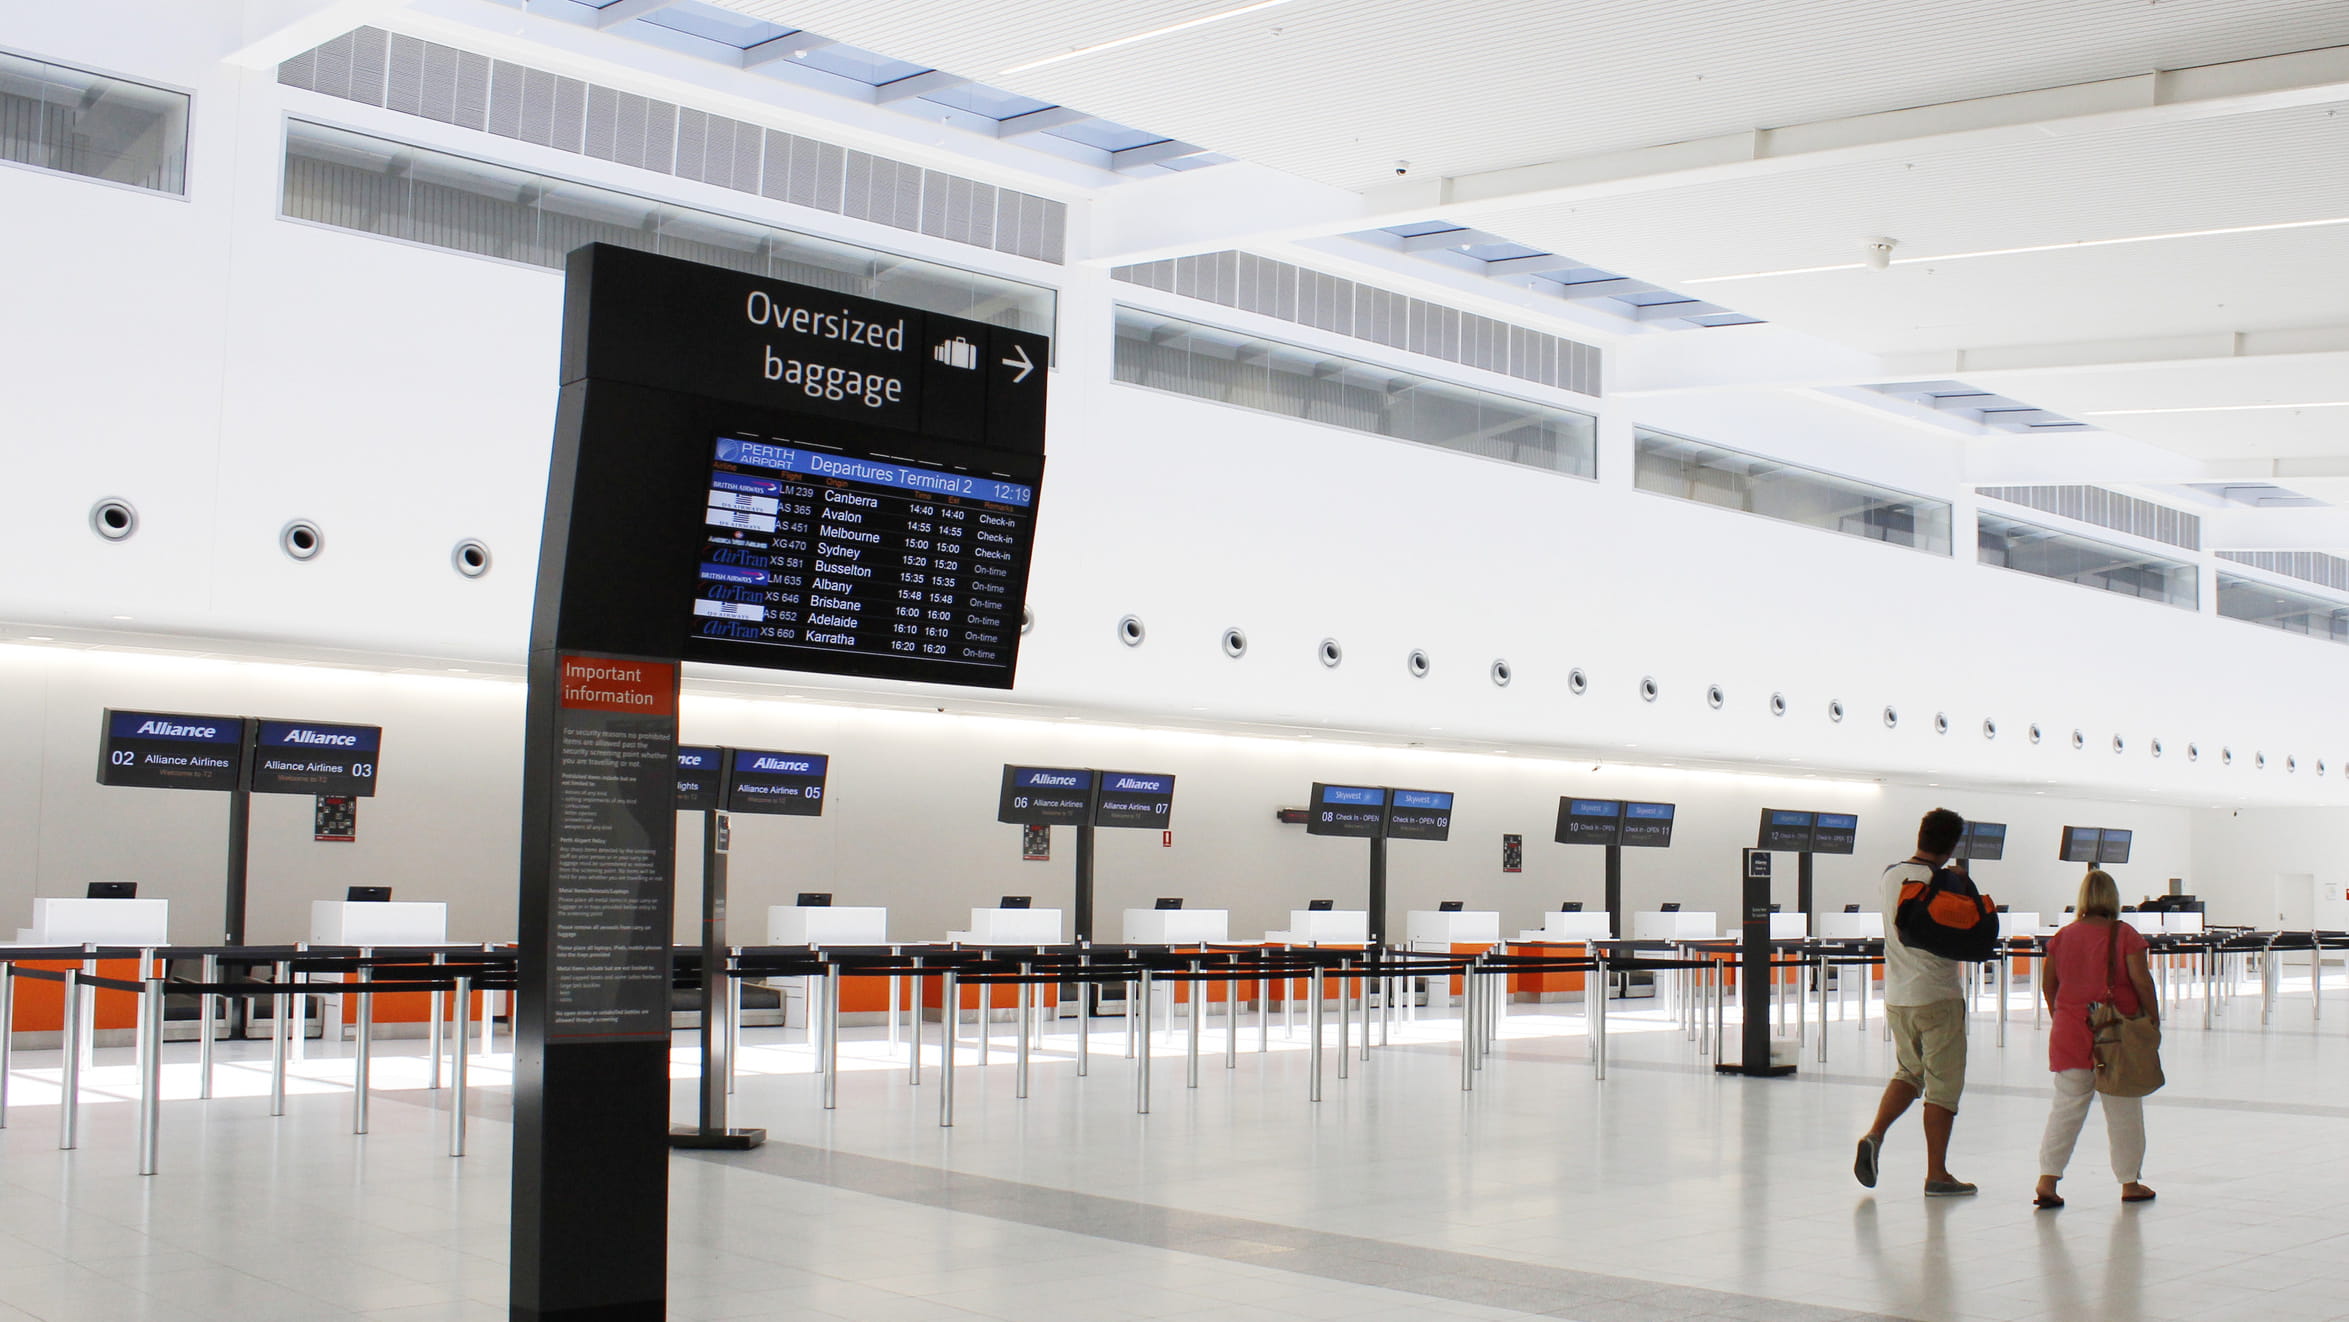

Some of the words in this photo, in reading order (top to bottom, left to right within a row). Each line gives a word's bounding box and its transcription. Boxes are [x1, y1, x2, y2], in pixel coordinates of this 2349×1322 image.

[746, 291, 904, 352] Oversized
[765, 345, 902, 407] baggage
[741, 442, 795, 460] PERTH
[740, 455, 793, 470] AIRPORT
[781, 471, 802, 481] Flight
[826, 478, 849, 488] Origin
[811, 455, 893, 481] Departures
[898, 469, 960, 492] Terminal
[963, 480, 972, 494] 2
[994, 484, 1031, 502] 12:19
[713, 481, 738, 491] BRITISH
[739, 483, 764, 494] AIRWAYS
[779, 485, 794, 494] LM
[796, 485, 814, 498] 239
[824, 490, 878, 508] Canberra
[910, 504, 934, 515] 14:40
[941, 509, 964, 520] 14:40
[979, 515, 1015, 528] Check-in
[778, 502, 791, 513] AS
[794, 503, 811, 515] 365
[822, 508, 862, 523] Avalon
[907, 522, 931, 532] 14:55
[939, 526, 962, 536] 14:55
[977, 531, 1012, 544] Check-in
[775, 520, 789, 530] AS
[791, 521, 808, 532] 451
[820, 525, 880, 543] Melbourne
[905, 538, 928, 549] 15:00
[937, 543, 960, 553] 15:00
[975, 548, 1011, 560] Check-in
[772, 538, 788, 548] XG
[789, 540, 806, 550] 470
[818, 543, 860, 560] Sydney
[903, 555, 927, 566] 15:20
[934, 559, 958, 570] 15:20
[974, 565, 1007, 576] On-time
[701, 572, 726, 580] BRITISH
[727, 574, 752, 583] AIRWAYS
[769, 556, 784, 566] XS
[786, 557, 803, 568] 581
[815, 560, 871, 577] Busselton
[900, 573, 924, 583] 15:35
[932, 577, 955, 587] 15:35
[972, 581, 1004, 593] On-time
[768, 575, 782, 583] LM
[784, 576, 802, 586] 635
[812, 578, 852, 595] Albany
[898, 590, 922, 600] 15:48
[929, 594, 952, 604] 15:48
[970, 598, 1002, 610] On-time
[765, 591, 780, 600] XS
[782, 593, 799, 603] 646
[810, 595, 861, 611] Brisbane
[896, 607, 919, 617] 16:00
[928, 610, 951, 620] 16:00
[968, 615, 1000, 626] On-time
[764, 609, 778, 619] AS
[779, 611, 797, 621] 652
[808, 613, 858, 628] Adelaide
[893, 624, 918, 634] 16:10
[925, 627, 948, 638] 16:10
[965, 631, 998, 643] On-time
[760, 627, 775, 636] XS
[777, 628, 794, 639] 660
[806, 630, 854, 646] Karratha
[891, 641, 915, 651] 16:20
[923, 644, 946, 654] 16:20
[963, 648, 995, 659] On-time
[566, 663, 641, 682] Important
[565, 685, 654, 705] information
[137, 720, 217, 739] Alliance
[284, 729, 356, 746] Alliance
[111, 750, 135, 766] 02
[144, 754, 187, 766] Alliance
[190, 757, 229, 768] Airlines
[562, 748, 588, 757] security
[265, 760, 304, 771] Alliance
[306, 763, 343, 774] Airlines
[352, 763, 372, 777] 03
[753, 757, 809, 772] Alliance
[677, 781, 699, 791] lights
[1030, 773, 1076, 786] Alliance
[1116, 778, 1160, 790] Alliance
[738, 784, 768, 794] Alliance
[770, 786, 799, 796] Airlines
[805, 786, 821, 799] 05
[1336, 791, 1361, 800] Skywest
[1405, 795, 1430, 804] Skywest
[1014, 797, 1028, 809] 06
[1033, 799, 1058, 807] Alliance
[1060, 800, 1083, 808] Airlines
[1103, 802, 1127, 811] Alliance
[1155, 803, 1168, 814] 07
[1322, 811, 1333, 822] 08
[1336, 813, 1352, 821] Check
[1419, 817, 1435, 825] OPEN
[1437, 817, 1447, 828] 09
[1570, 822, 1579, 832] 10
[1662, 827, 1669, 836] 11
[1772, 832, 1779, 840] 12
